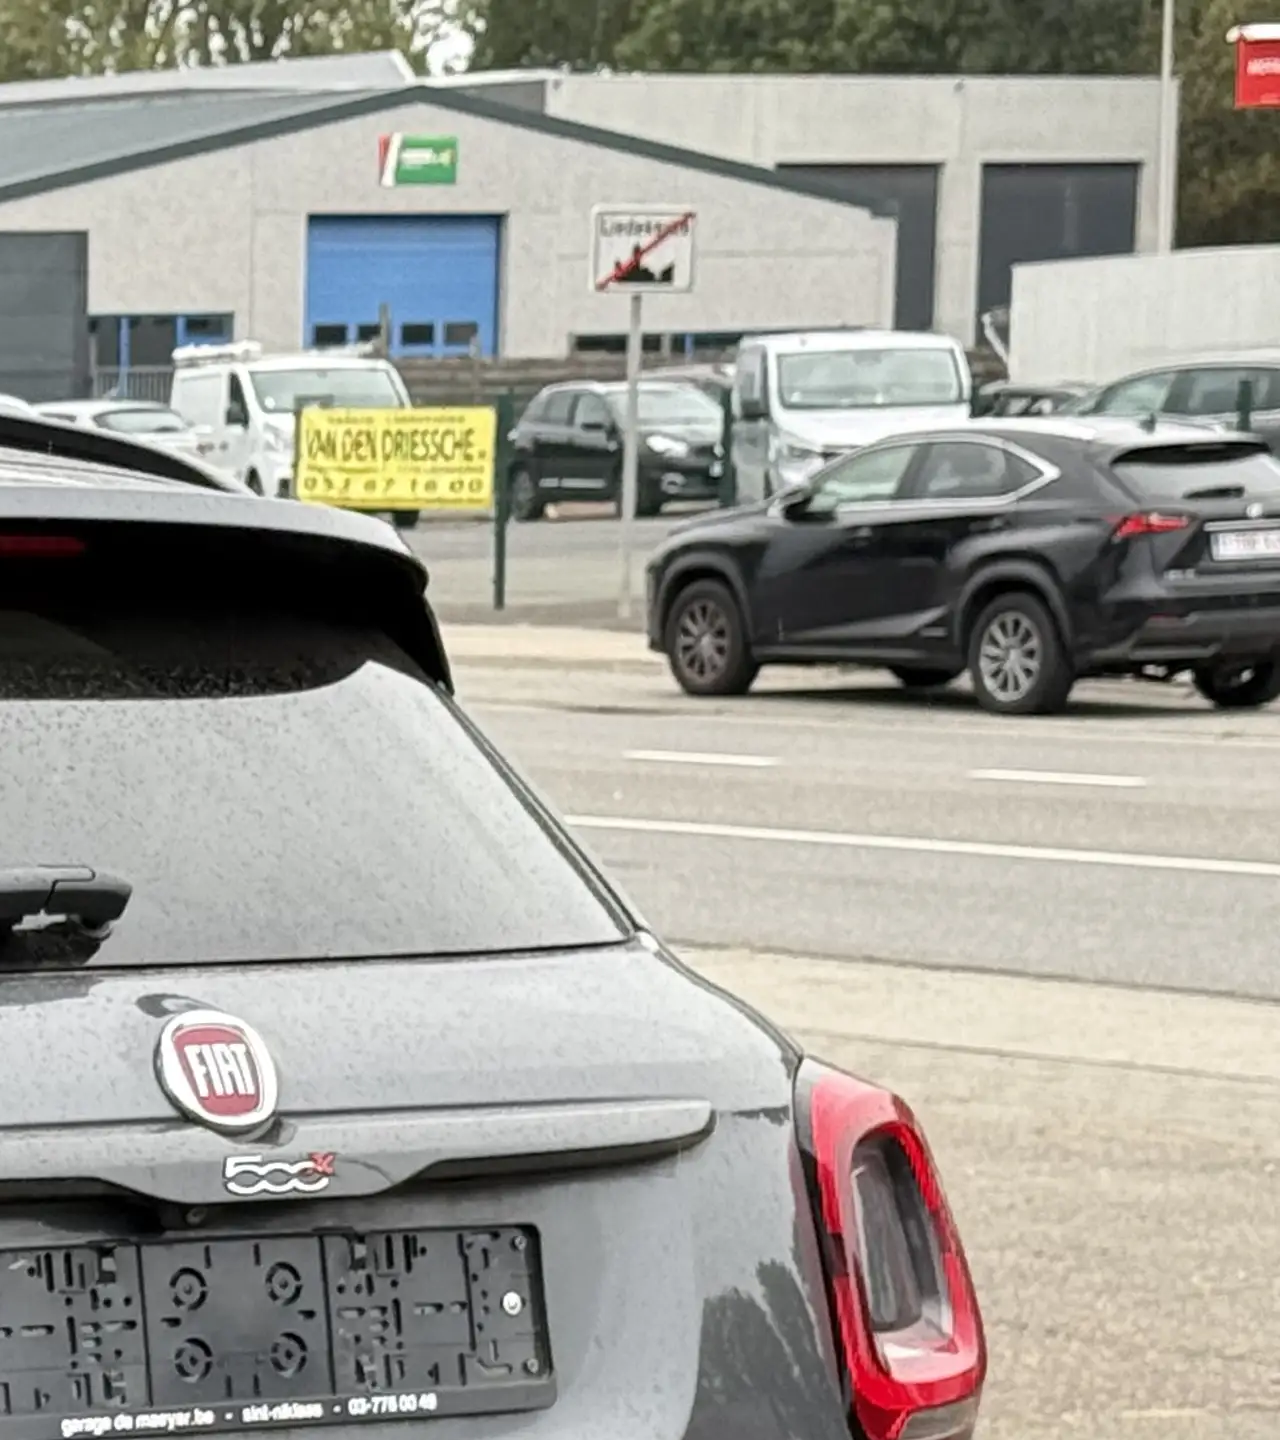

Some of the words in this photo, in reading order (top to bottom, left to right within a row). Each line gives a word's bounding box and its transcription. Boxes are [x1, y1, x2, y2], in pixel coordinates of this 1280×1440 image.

[306, 428, 336, 461] VAN
[341, 428, 377, 461] DEN
[184, 1043, 255, 1097] FIAT
[61, 1416, 112, 1438] garage
[399, 1393, 417, 1412] 00
